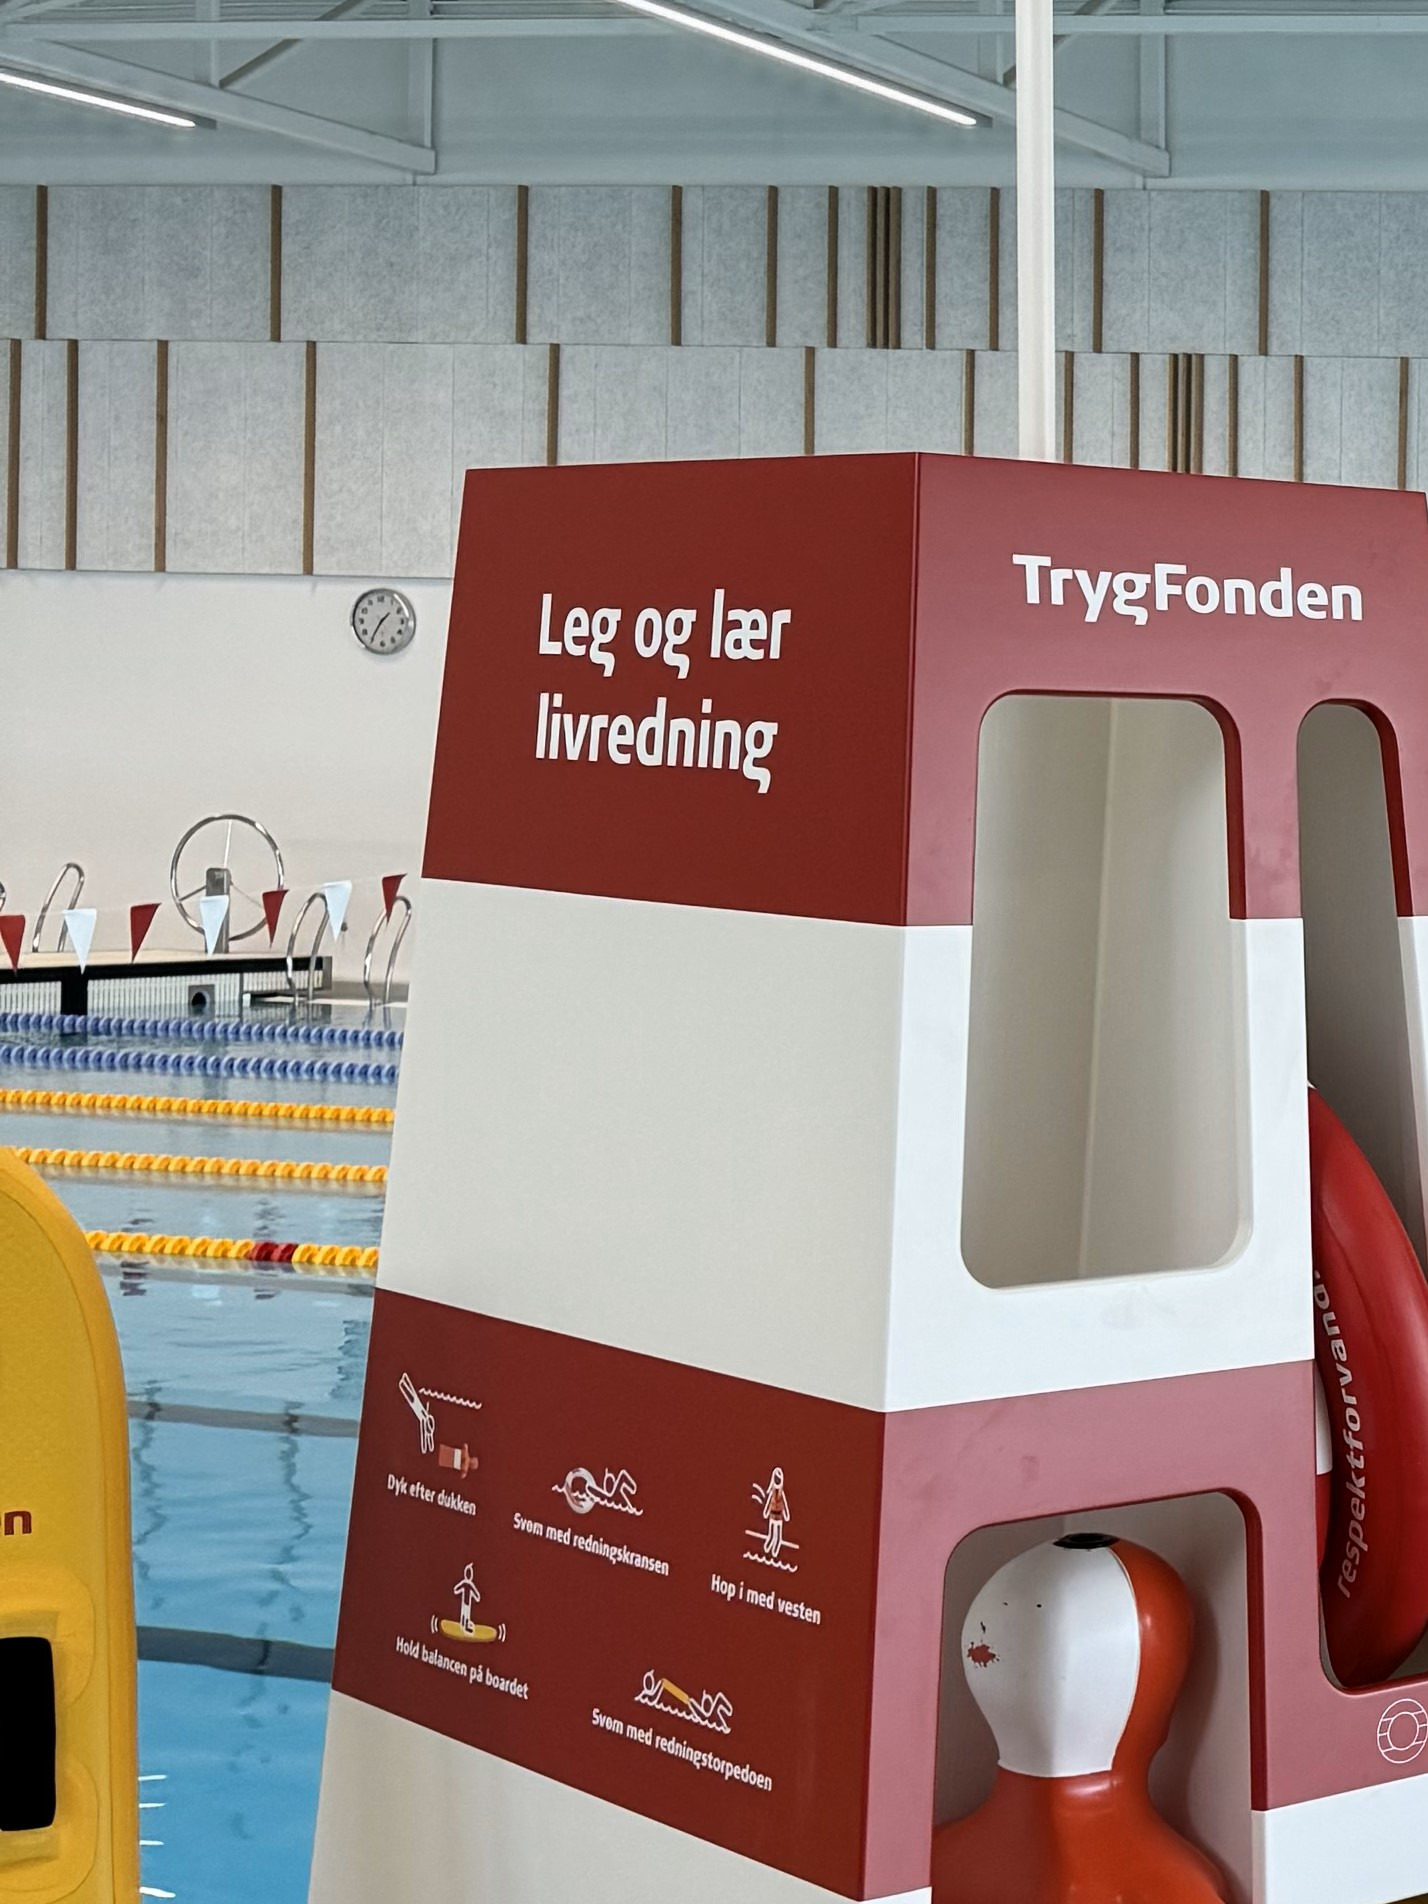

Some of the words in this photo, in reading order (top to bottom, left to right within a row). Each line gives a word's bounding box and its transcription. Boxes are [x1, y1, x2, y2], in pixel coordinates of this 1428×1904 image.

[1013, 553, 1363, 625] TrygFonden
[538, 592, 621, 677] Leg
[633, 606, 695, 679] og
[709, 588, 792, 661] lær
[534, 693, 779, 794] livredning
[387, 1473, 408, 1496] Dyk
[409, 1481, 436, 1504] efter
[437, 1488, 477, 1516] dukken
[546, 1524, 571, 1546] med
[573, 1533, 670, 1577] redningskransen
[711, 1573, 736, 1601] Hop
[738, 1581, 745, 1600] i
[746, 1589, 775, 1610] med
[777, 1598, 821, 1625] vesten
[396, 1635, 420, 1659] Hold
[421, 1645, 468, 1677] balancen
[469, 1664, 484, 1684] på
[485, 1668, 529, 1700] boardet
[626, 1724, 653, 1746] med
[655, 1736, 773, 1792] redningstorpedoen
